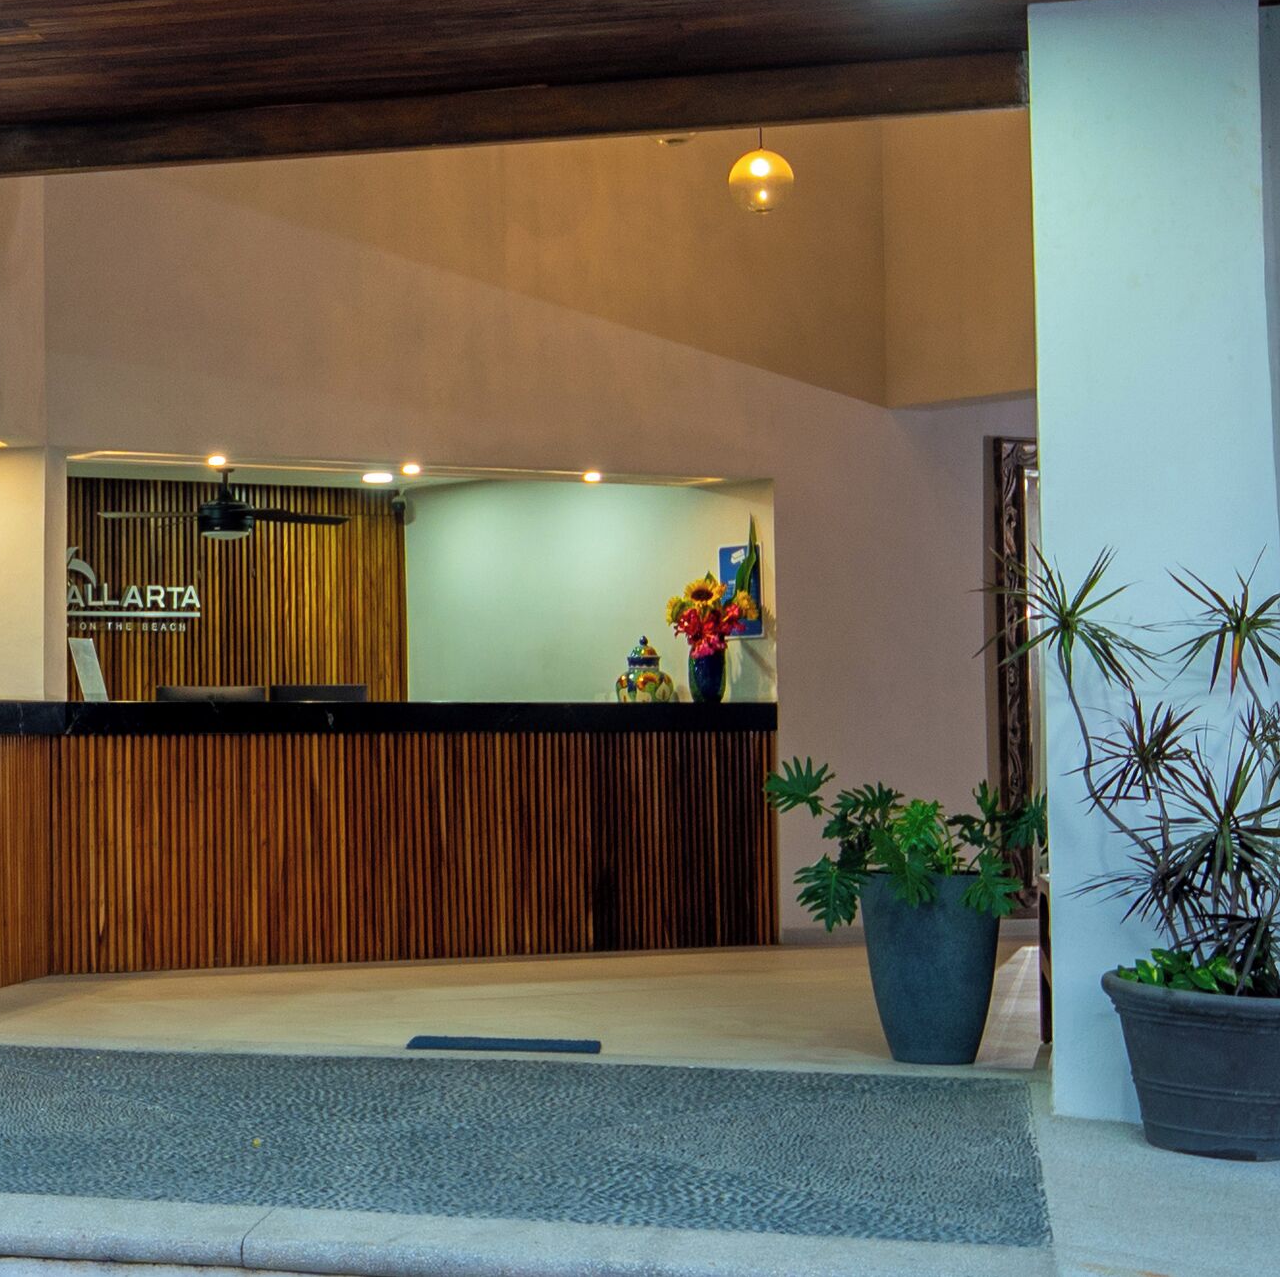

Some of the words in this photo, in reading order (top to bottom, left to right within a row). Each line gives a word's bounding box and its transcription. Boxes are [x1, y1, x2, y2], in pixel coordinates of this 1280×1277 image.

[66, 581, 201, 609] ALLARTA
[79, 622, 97, 631] ON
[106, 621, 132, 631] THE
[141, 622, 187, 632] BEACH
